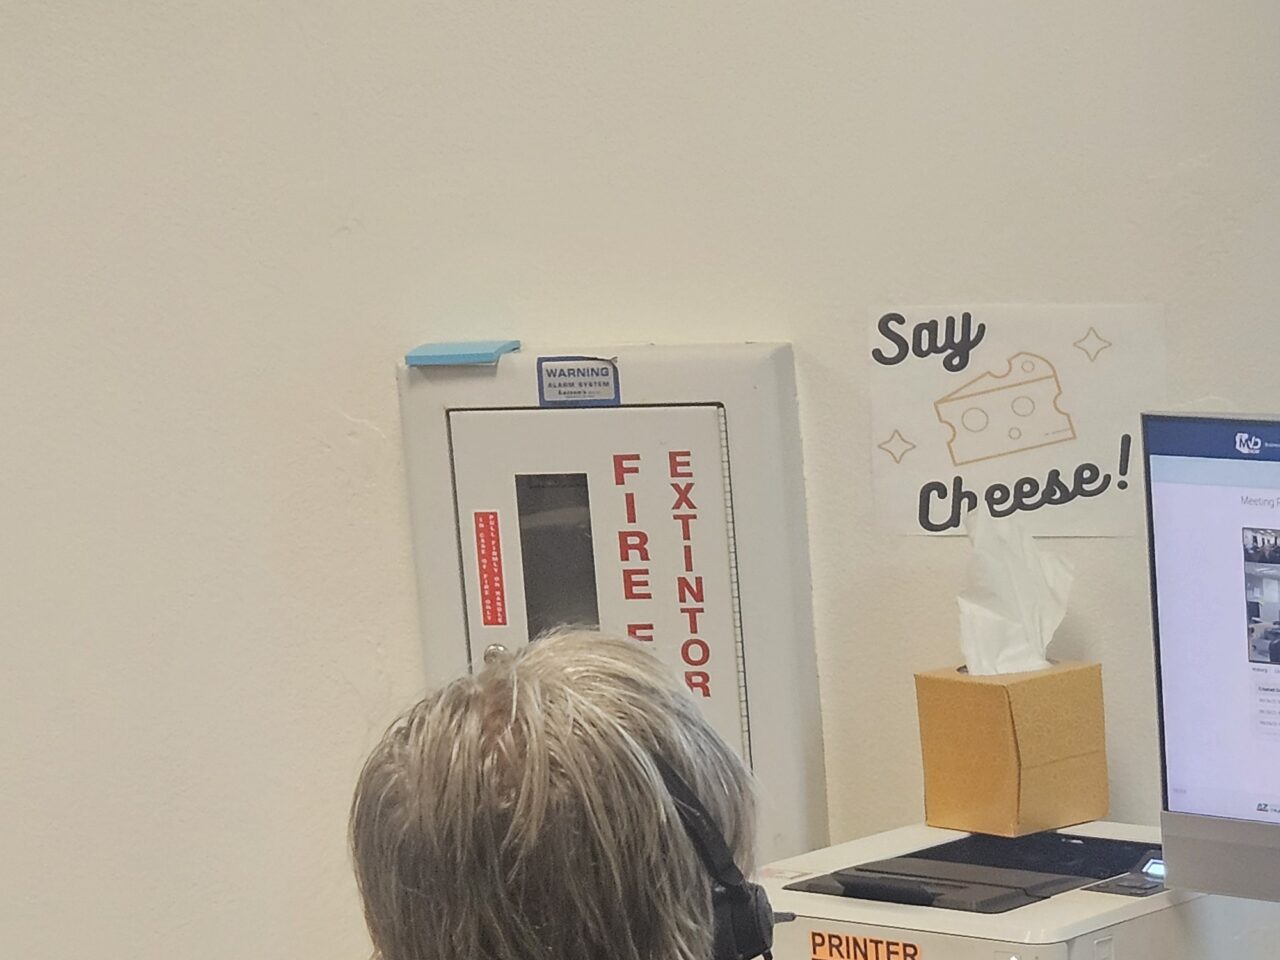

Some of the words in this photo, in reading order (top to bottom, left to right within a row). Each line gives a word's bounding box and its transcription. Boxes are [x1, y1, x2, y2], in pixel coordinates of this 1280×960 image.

[546, 367, 610, 378] WARNING
[872, 312, 986, 372] Say
[919, 433, 1131, 532] Cheese!
[1241, 496, 1275, 509] Meeting
[612, 453, 653, 600] FIRE
[668, 450, 711, 698] EXTINTOR
